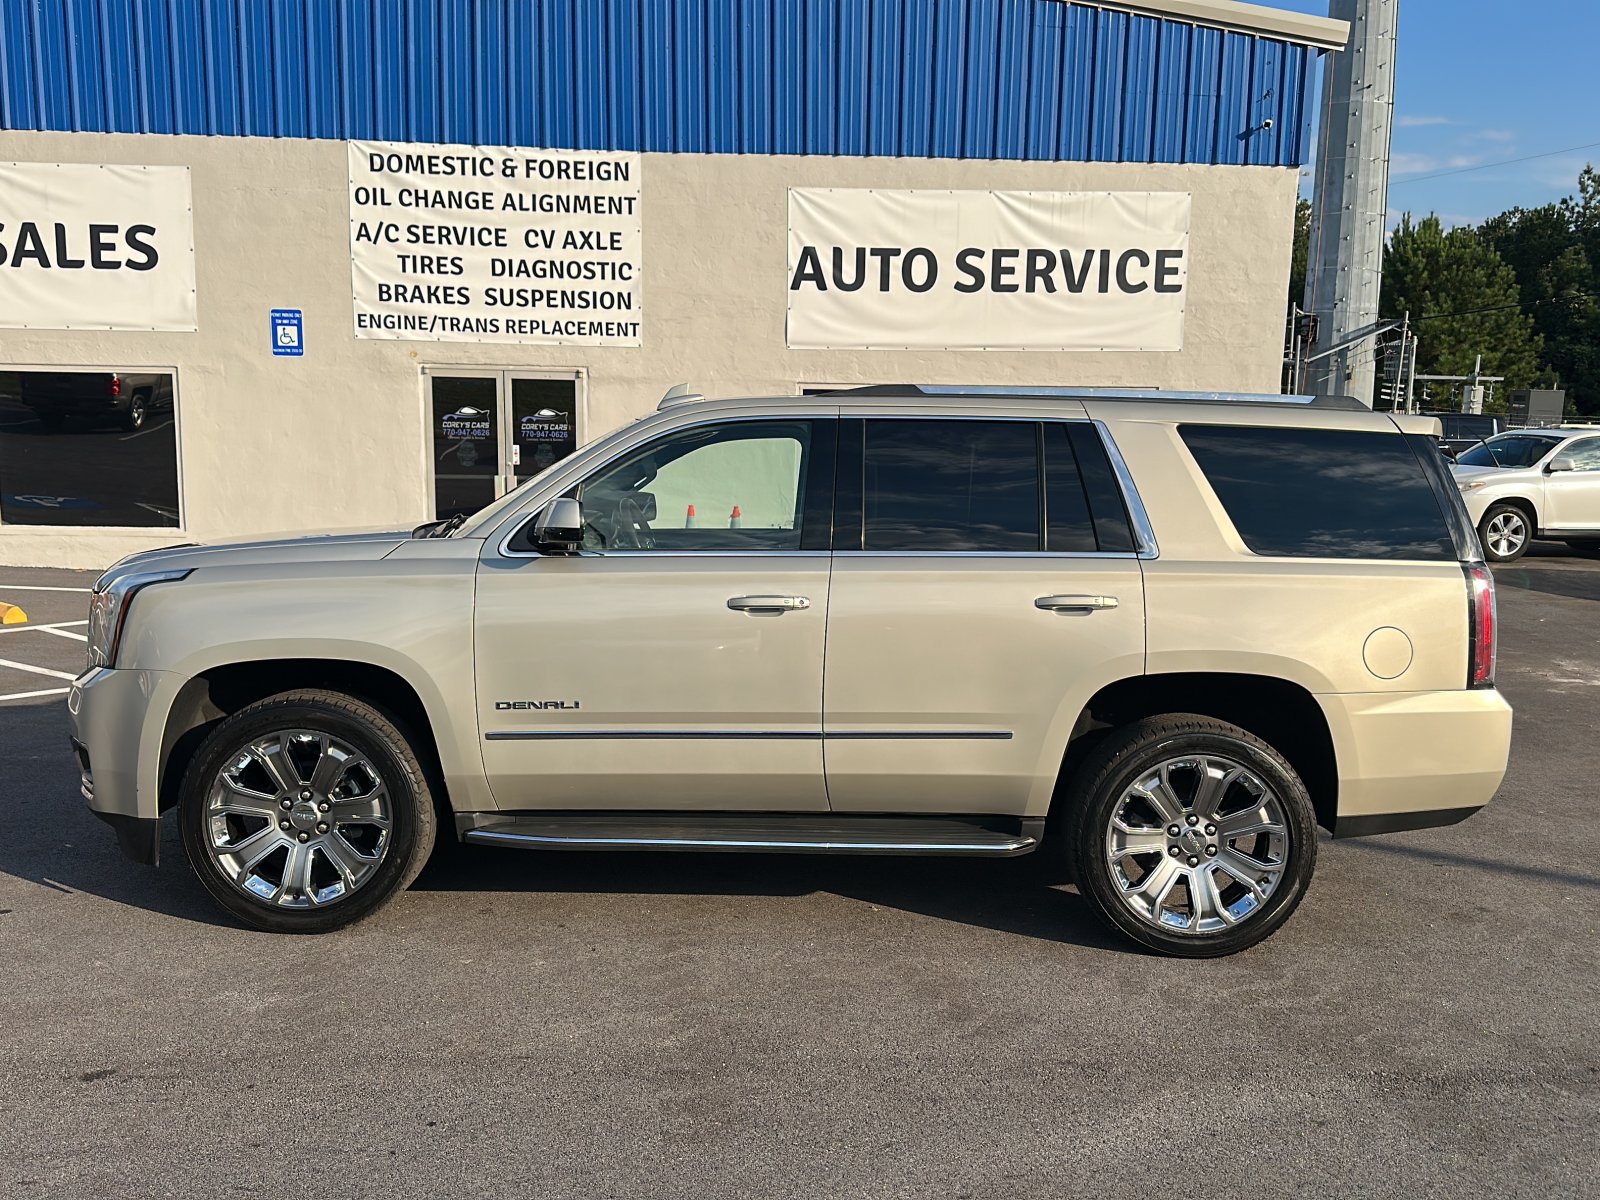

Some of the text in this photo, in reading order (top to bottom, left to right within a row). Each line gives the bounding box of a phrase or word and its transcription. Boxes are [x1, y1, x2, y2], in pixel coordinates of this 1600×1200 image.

[369, 152, 629, 182] DOMESTIC & FOREIGN
[354, 186, 637, 215] OIL CHANGE ALIGNMENT
[0, 221, 159, 271] ALES
[355, 221, 623, 251] A/C SERVICE CV AXLE
[396, 254, 633, 281] TIRES DIAGNOSTIC
[789, 246, 1184, 294] AUTO SERVICE
[378, 283, 632, 310] BRAKES SUSPENSION
[357, 313, 640, 337] ENGINE/TRANS REPLACEMENT
[442, 421, 470, 429] COREY'S
[442, 428, 490, 437] 770-947-0626
[521, 423, 549, 431] COREY'S
[521, 430, 568, 439] 770-947-0626
[495, 701, 580, 710] DENALI
